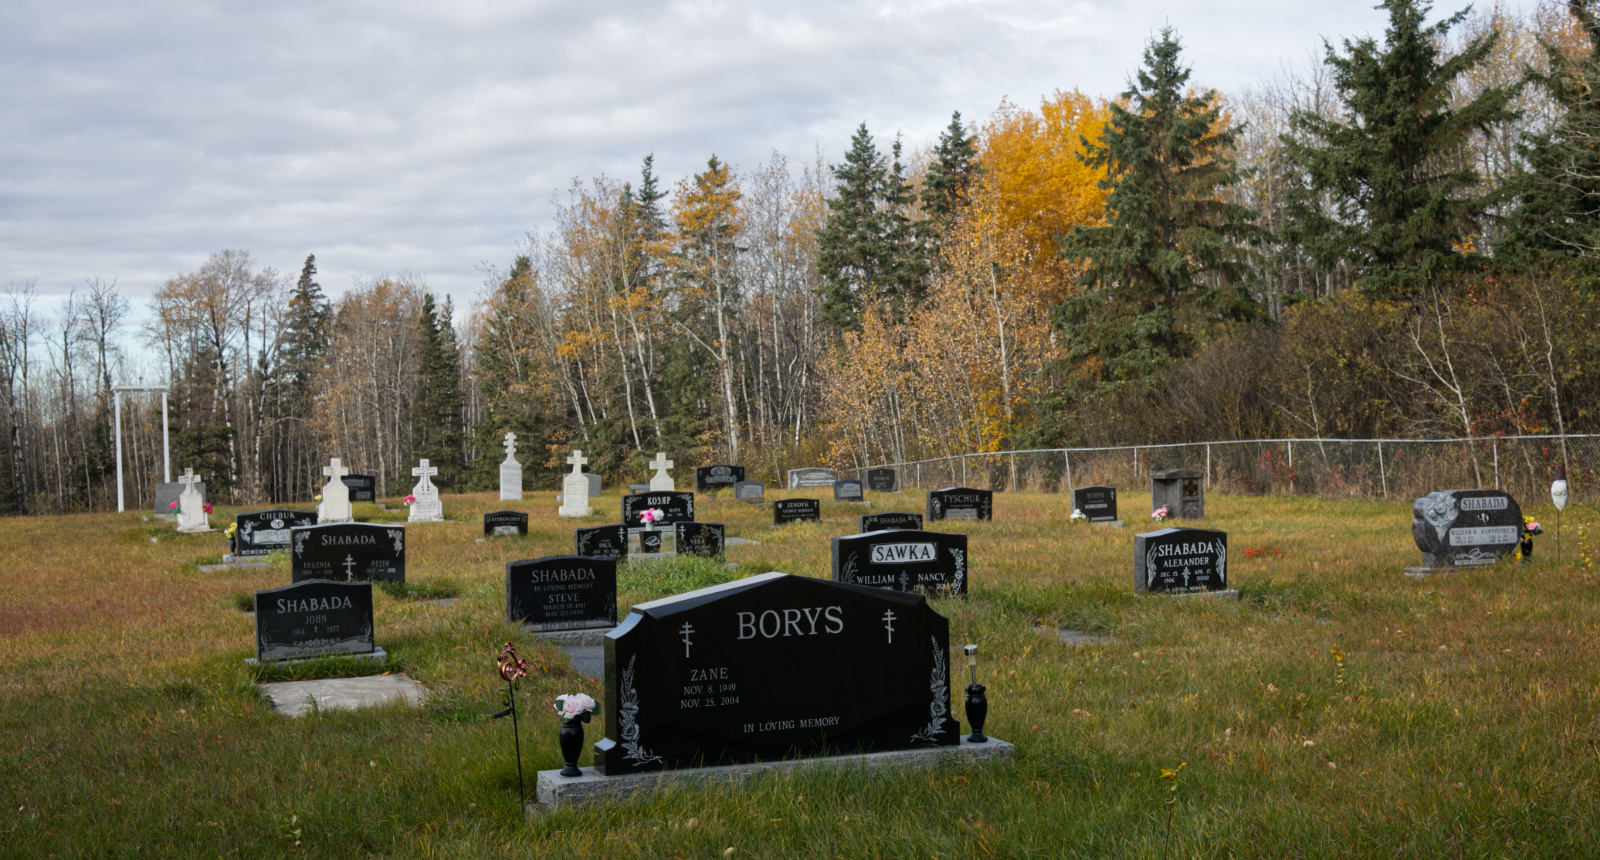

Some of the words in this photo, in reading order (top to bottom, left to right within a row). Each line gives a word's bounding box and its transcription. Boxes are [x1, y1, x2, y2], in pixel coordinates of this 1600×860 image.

[647, 496, 671, 506] КОЗЯР
[943, 494, 980, 503] TYSCHUK
[1463, 499, 1505, 510] SHABADA
[260, 511, 295, 520] CHEBUK
[321, 534, 376, 546] SHABADA
[876, 544, 931, 562] SAWKA
[1158, 542, 1214, 557] SHABADA
[1163, 557, 1210, 568] ALEXANDER
[531, 568, 596, 583] SHABADA
[856, 574, 895, 585] WILLIAM
[917, 572, 946, 582] NANCY
[548, 593, 580, 603] STEVE
[277, 596, 353, 614] SHABADA
[305, 614, 327, 625] JOHN
[736, 606, 844, 640] BORYS
[690, 667, 728, 681] ZANE
[683, 685, 704, 696] NOV.
[719, 683, 736, 693] 1949
[680, 699, 701, 709] NOV.
[720, 696, 740, 706] 2004
[744, 723, 754, 733] IN
[759, 720, 795, 732] LOVING
[800, 716, 840, 728] MEMORY
